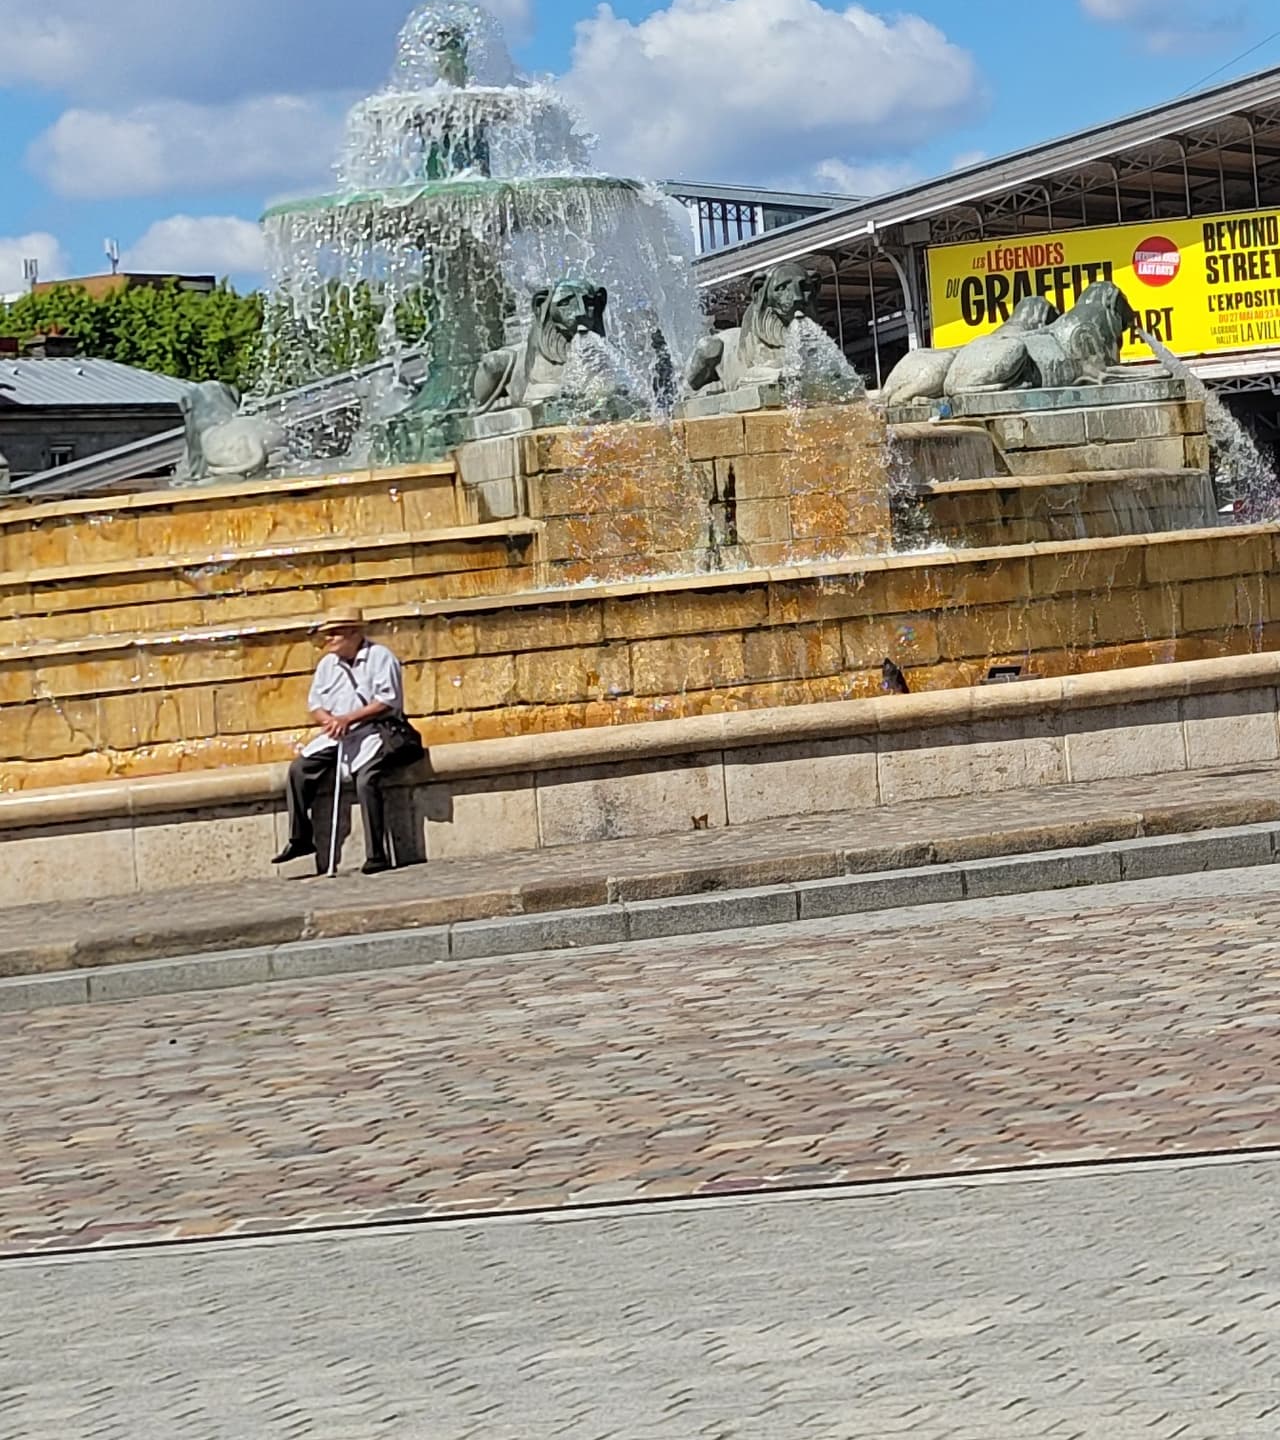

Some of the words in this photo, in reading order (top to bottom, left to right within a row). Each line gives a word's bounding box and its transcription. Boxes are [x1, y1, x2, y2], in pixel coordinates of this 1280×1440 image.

[1202, 216, 1279, 253] BEYOND
[972, 256, 986, 270] LES
[987, 242, 1065, 273] LÉGENDES
[946, 278, 960, 299] DU
[1218, 314, 1228, 323] DU
[1240, 311, 1253, 320] MAI
[1254, 310, 1264, 320] AU
[1240, 323, 1255, 342] LA
